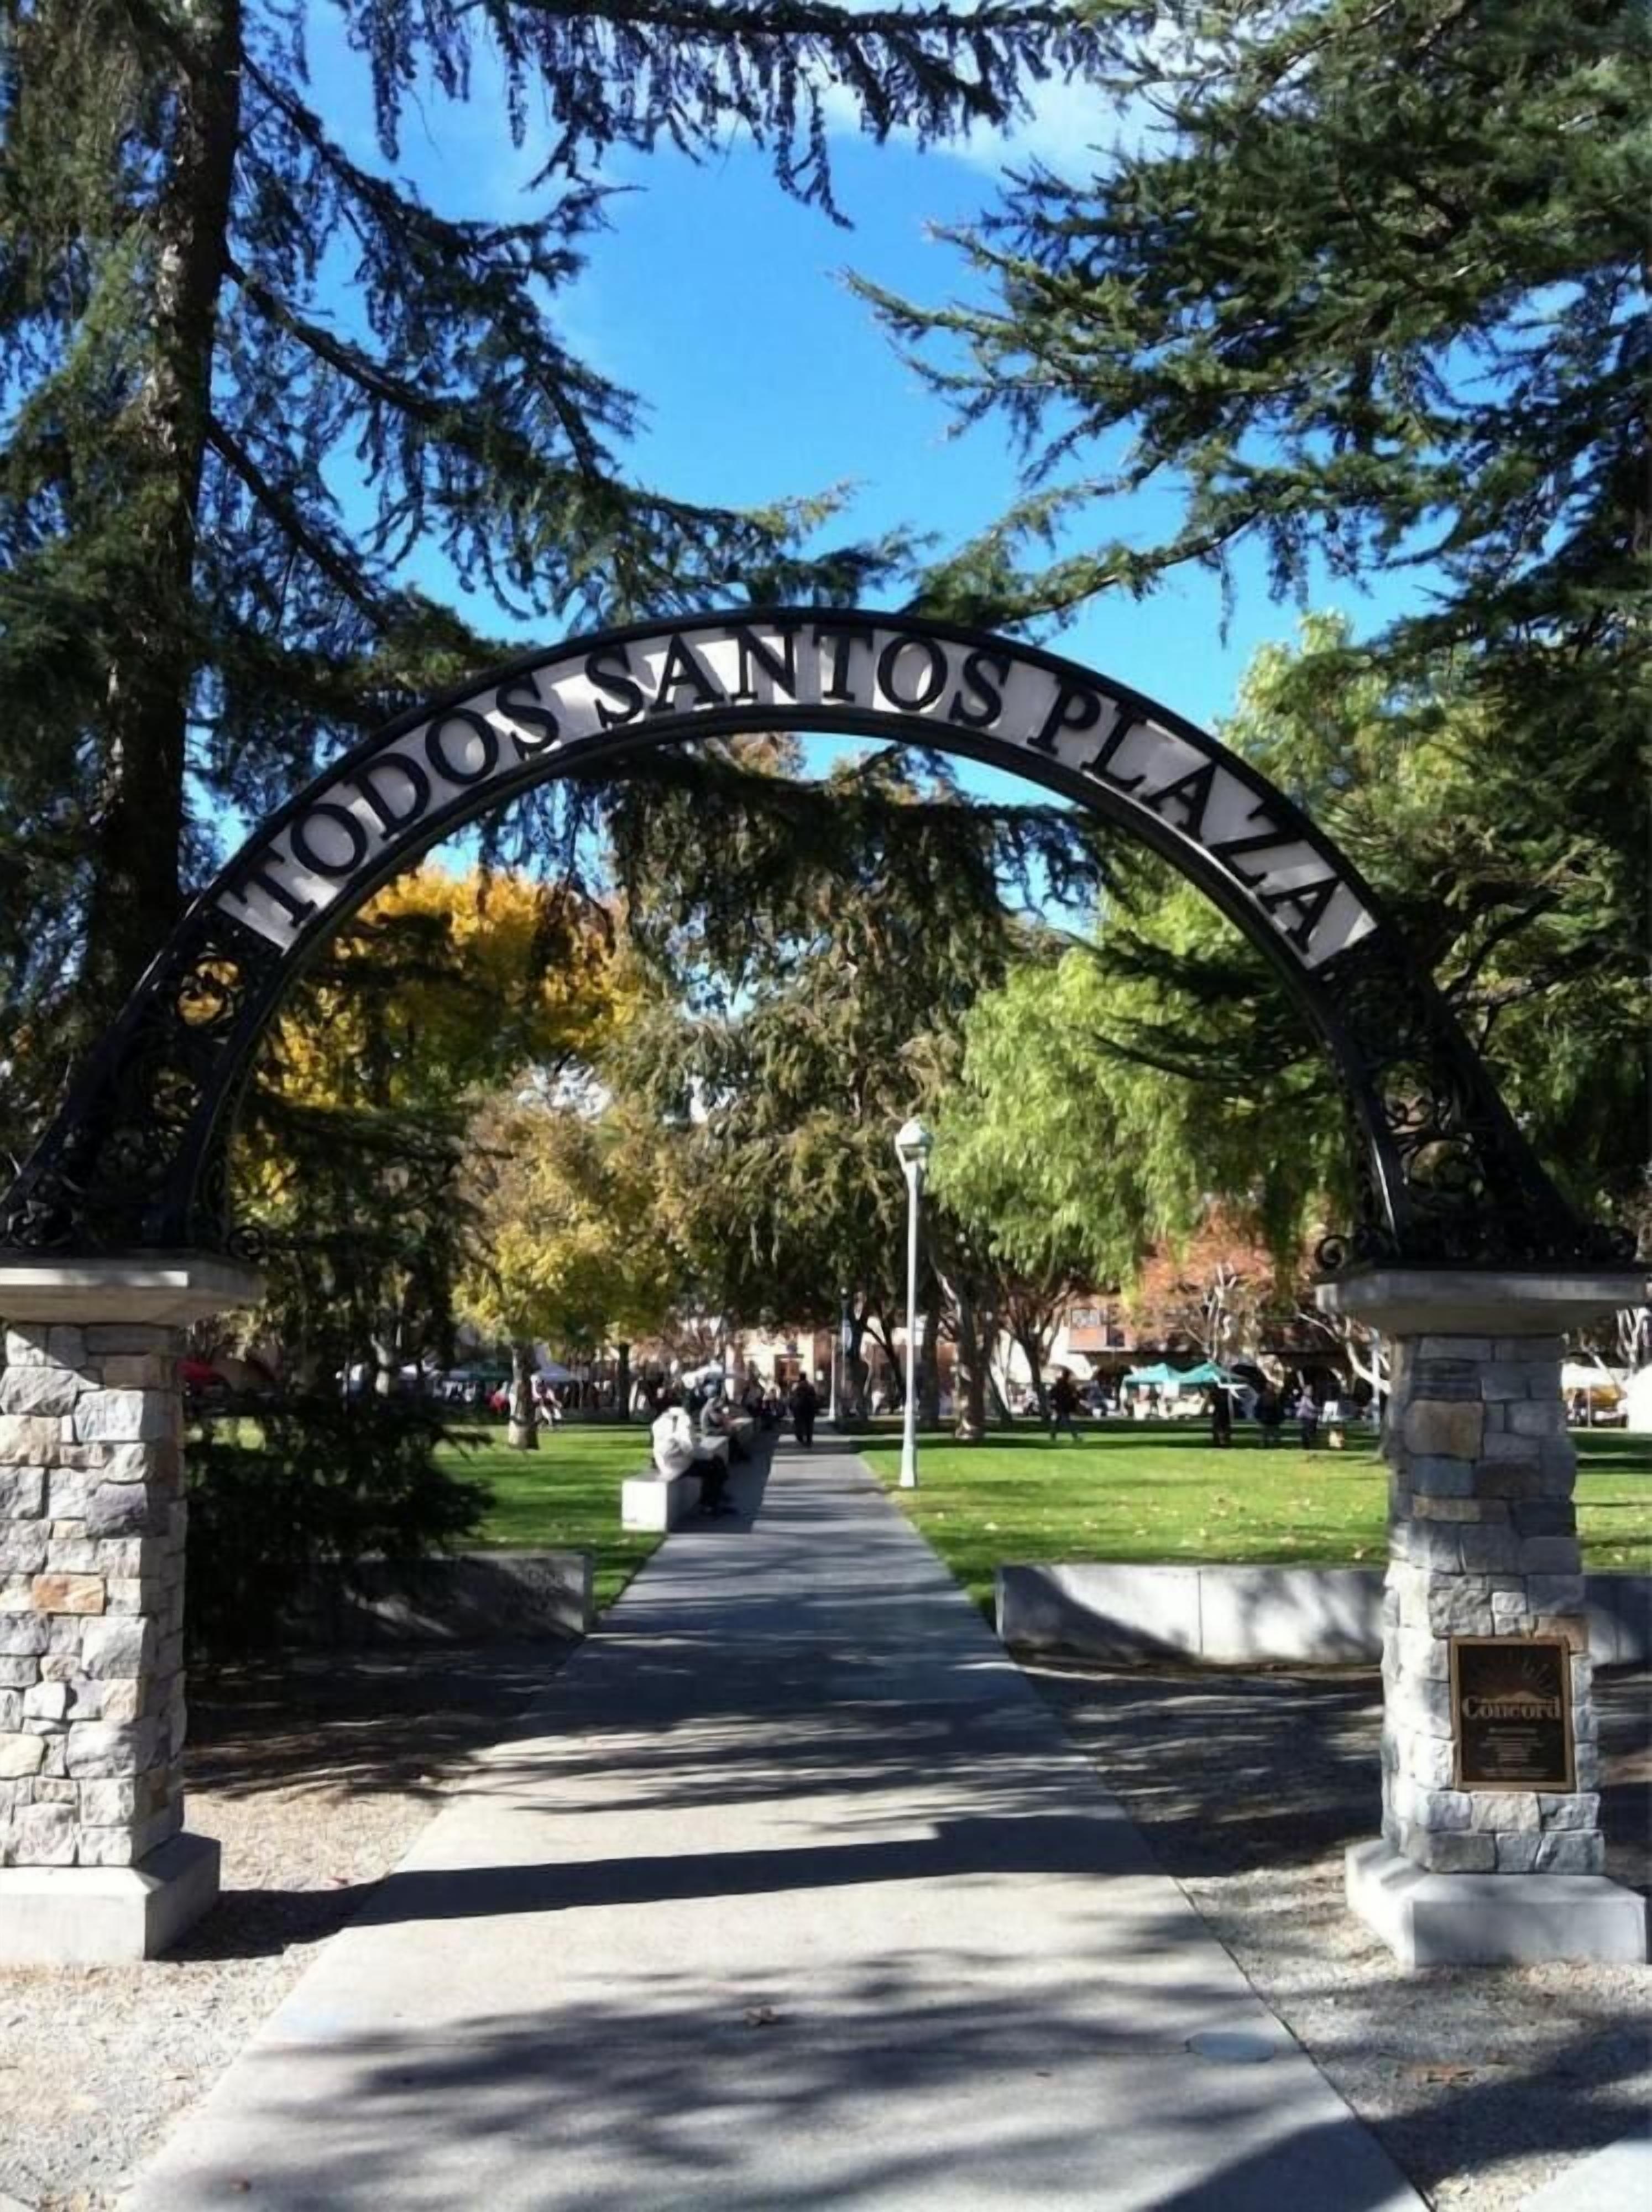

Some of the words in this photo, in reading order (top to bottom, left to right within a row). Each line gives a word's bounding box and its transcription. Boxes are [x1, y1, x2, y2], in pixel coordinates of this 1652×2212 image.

[223, 671, 560, 928] TODOS
[584, 623, 1011, 728] SANTOS
[1027, 675, 1345, 954] PLAZA
[1462, 1695, 1561, 1719] Concord
